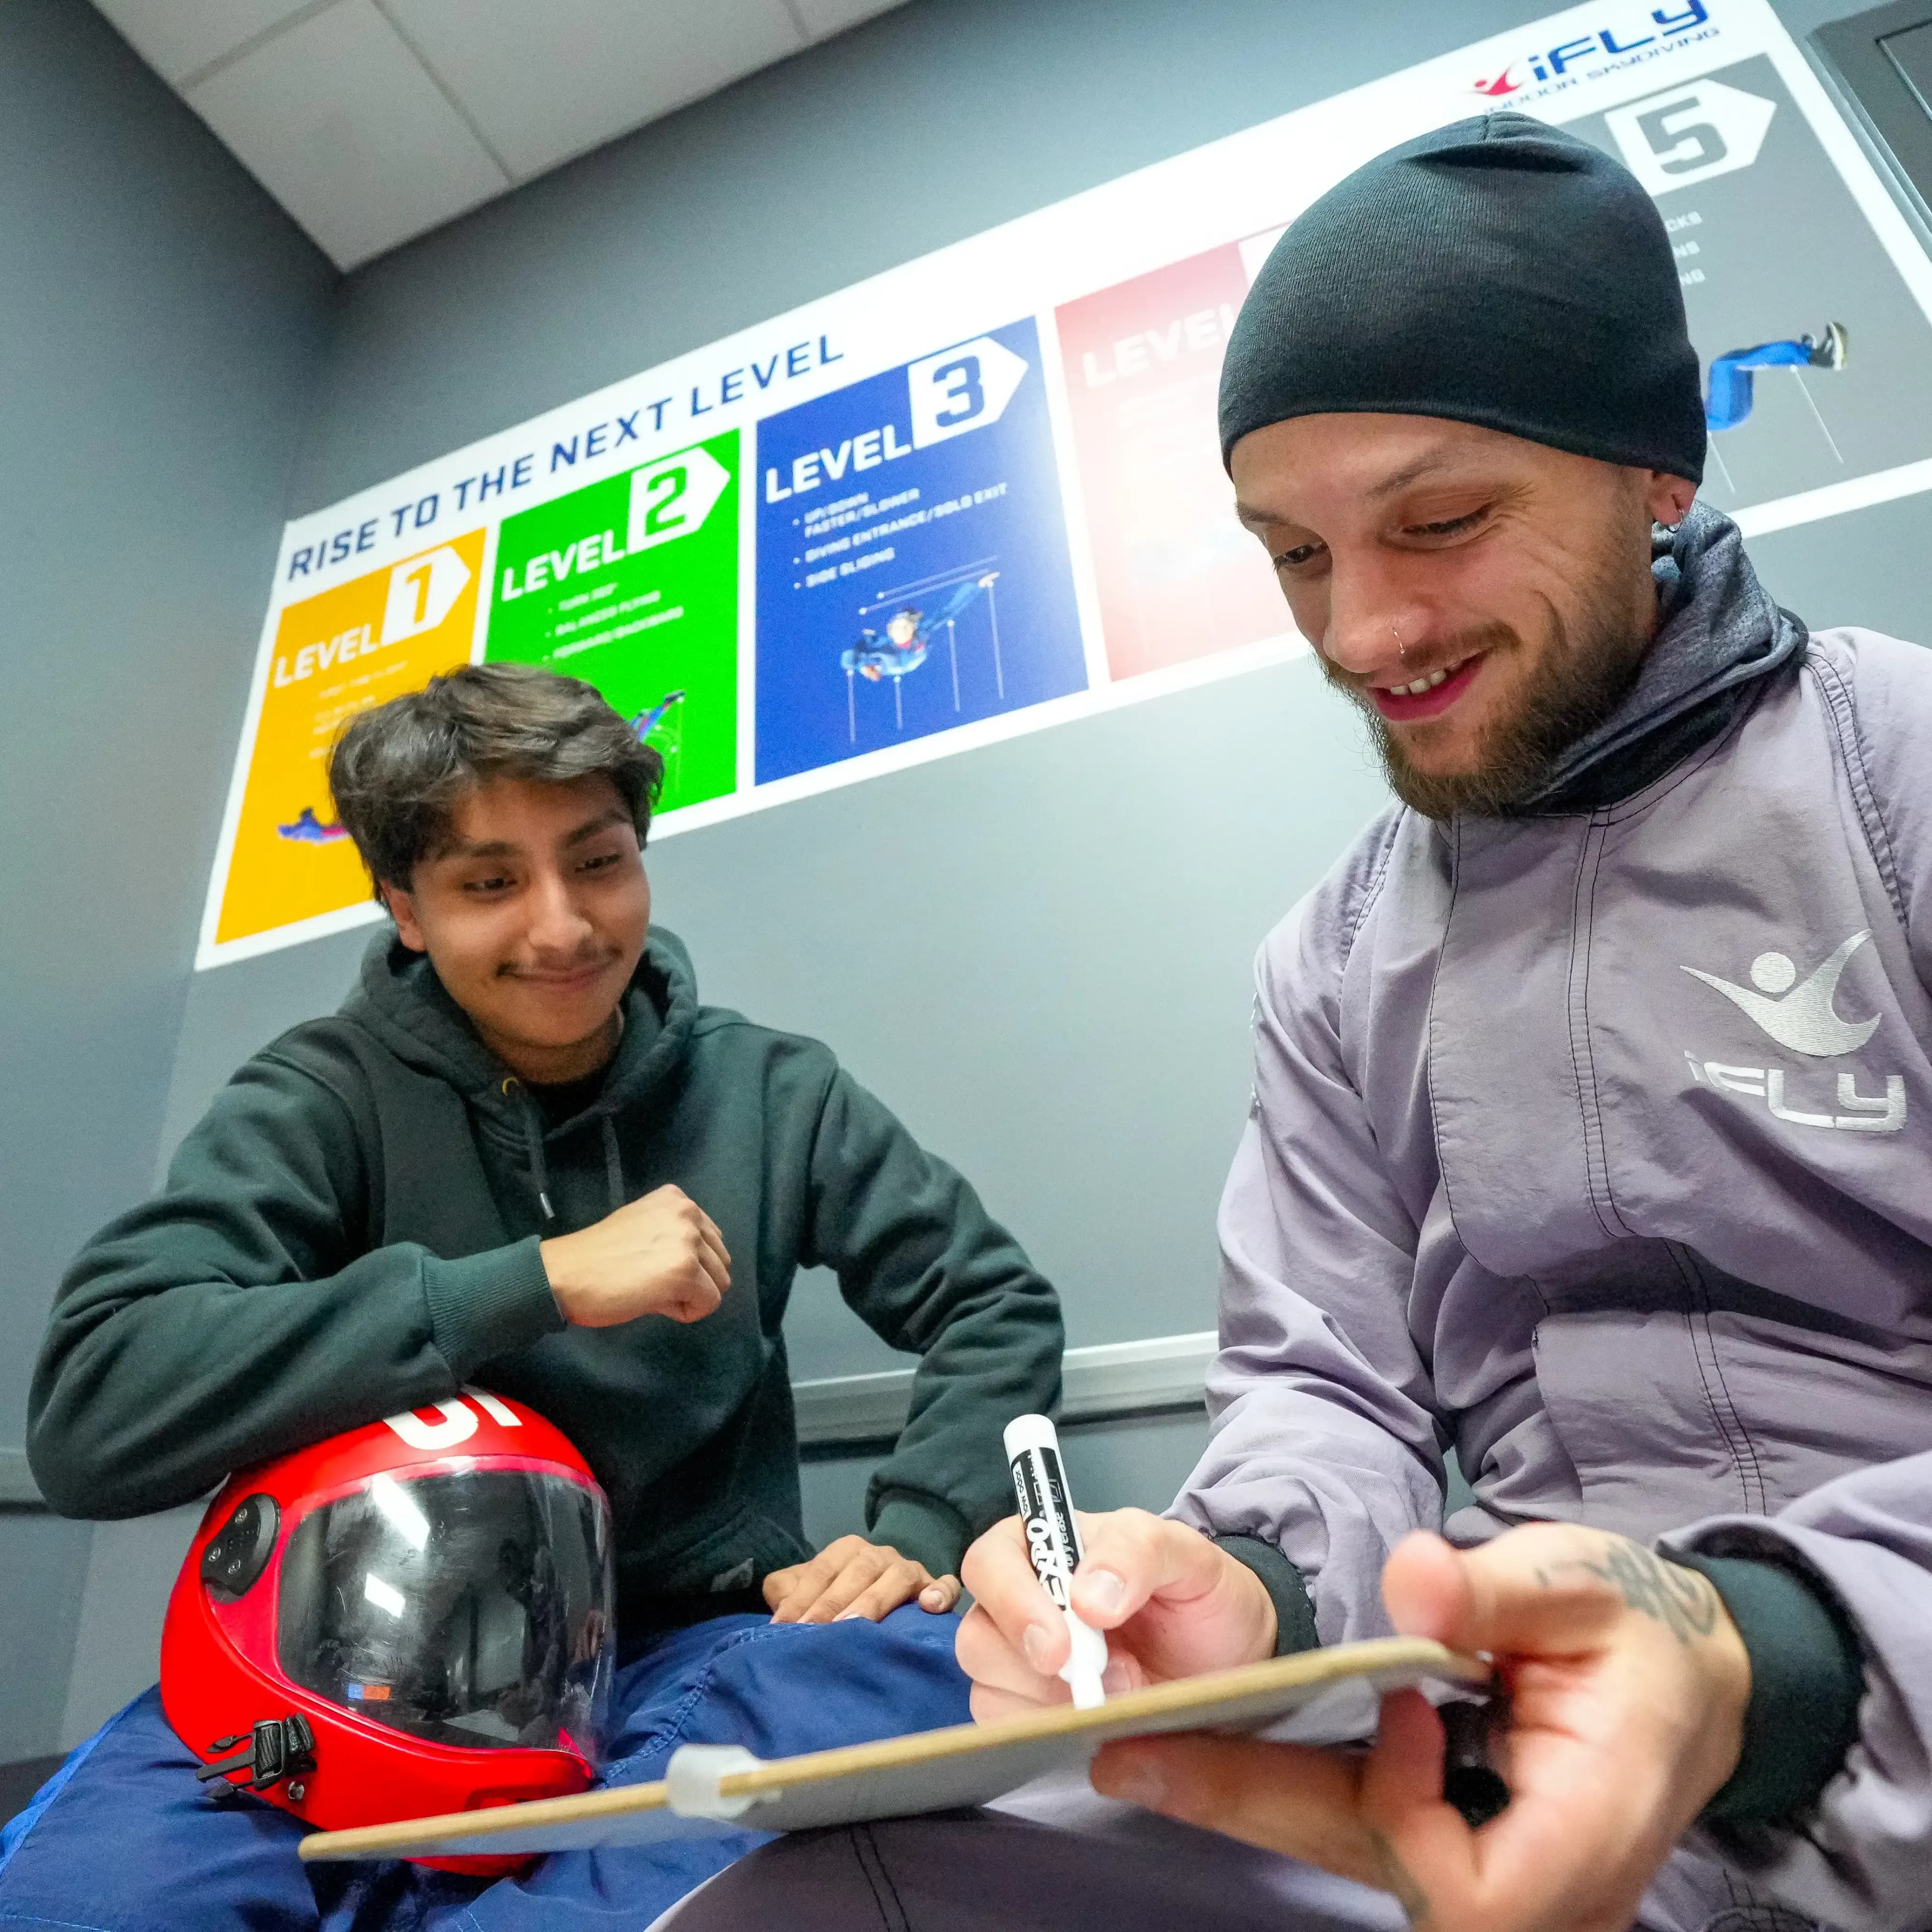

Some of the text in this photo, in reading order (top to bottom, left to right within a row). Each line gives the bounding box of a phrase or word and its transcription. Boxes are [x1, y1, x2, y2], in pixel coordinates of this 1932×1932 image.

[1586, 27, 1720, 78] SKYDIVING
[1636, 96, 1728, 175] 5
[287, 335, 844, 581] RISE TO THE NEXT LEVEL
[766, 356, 985, 503] LEVEL 3
[502, 466, 687, 601] LEVEL 2
[273, 621, 381, 688] LEVEL
[403, 563, 432, 624] 1
[1015, 1469, 1029, 1516] low odor
[1026, 1517, 1071, 1606] EXPO
